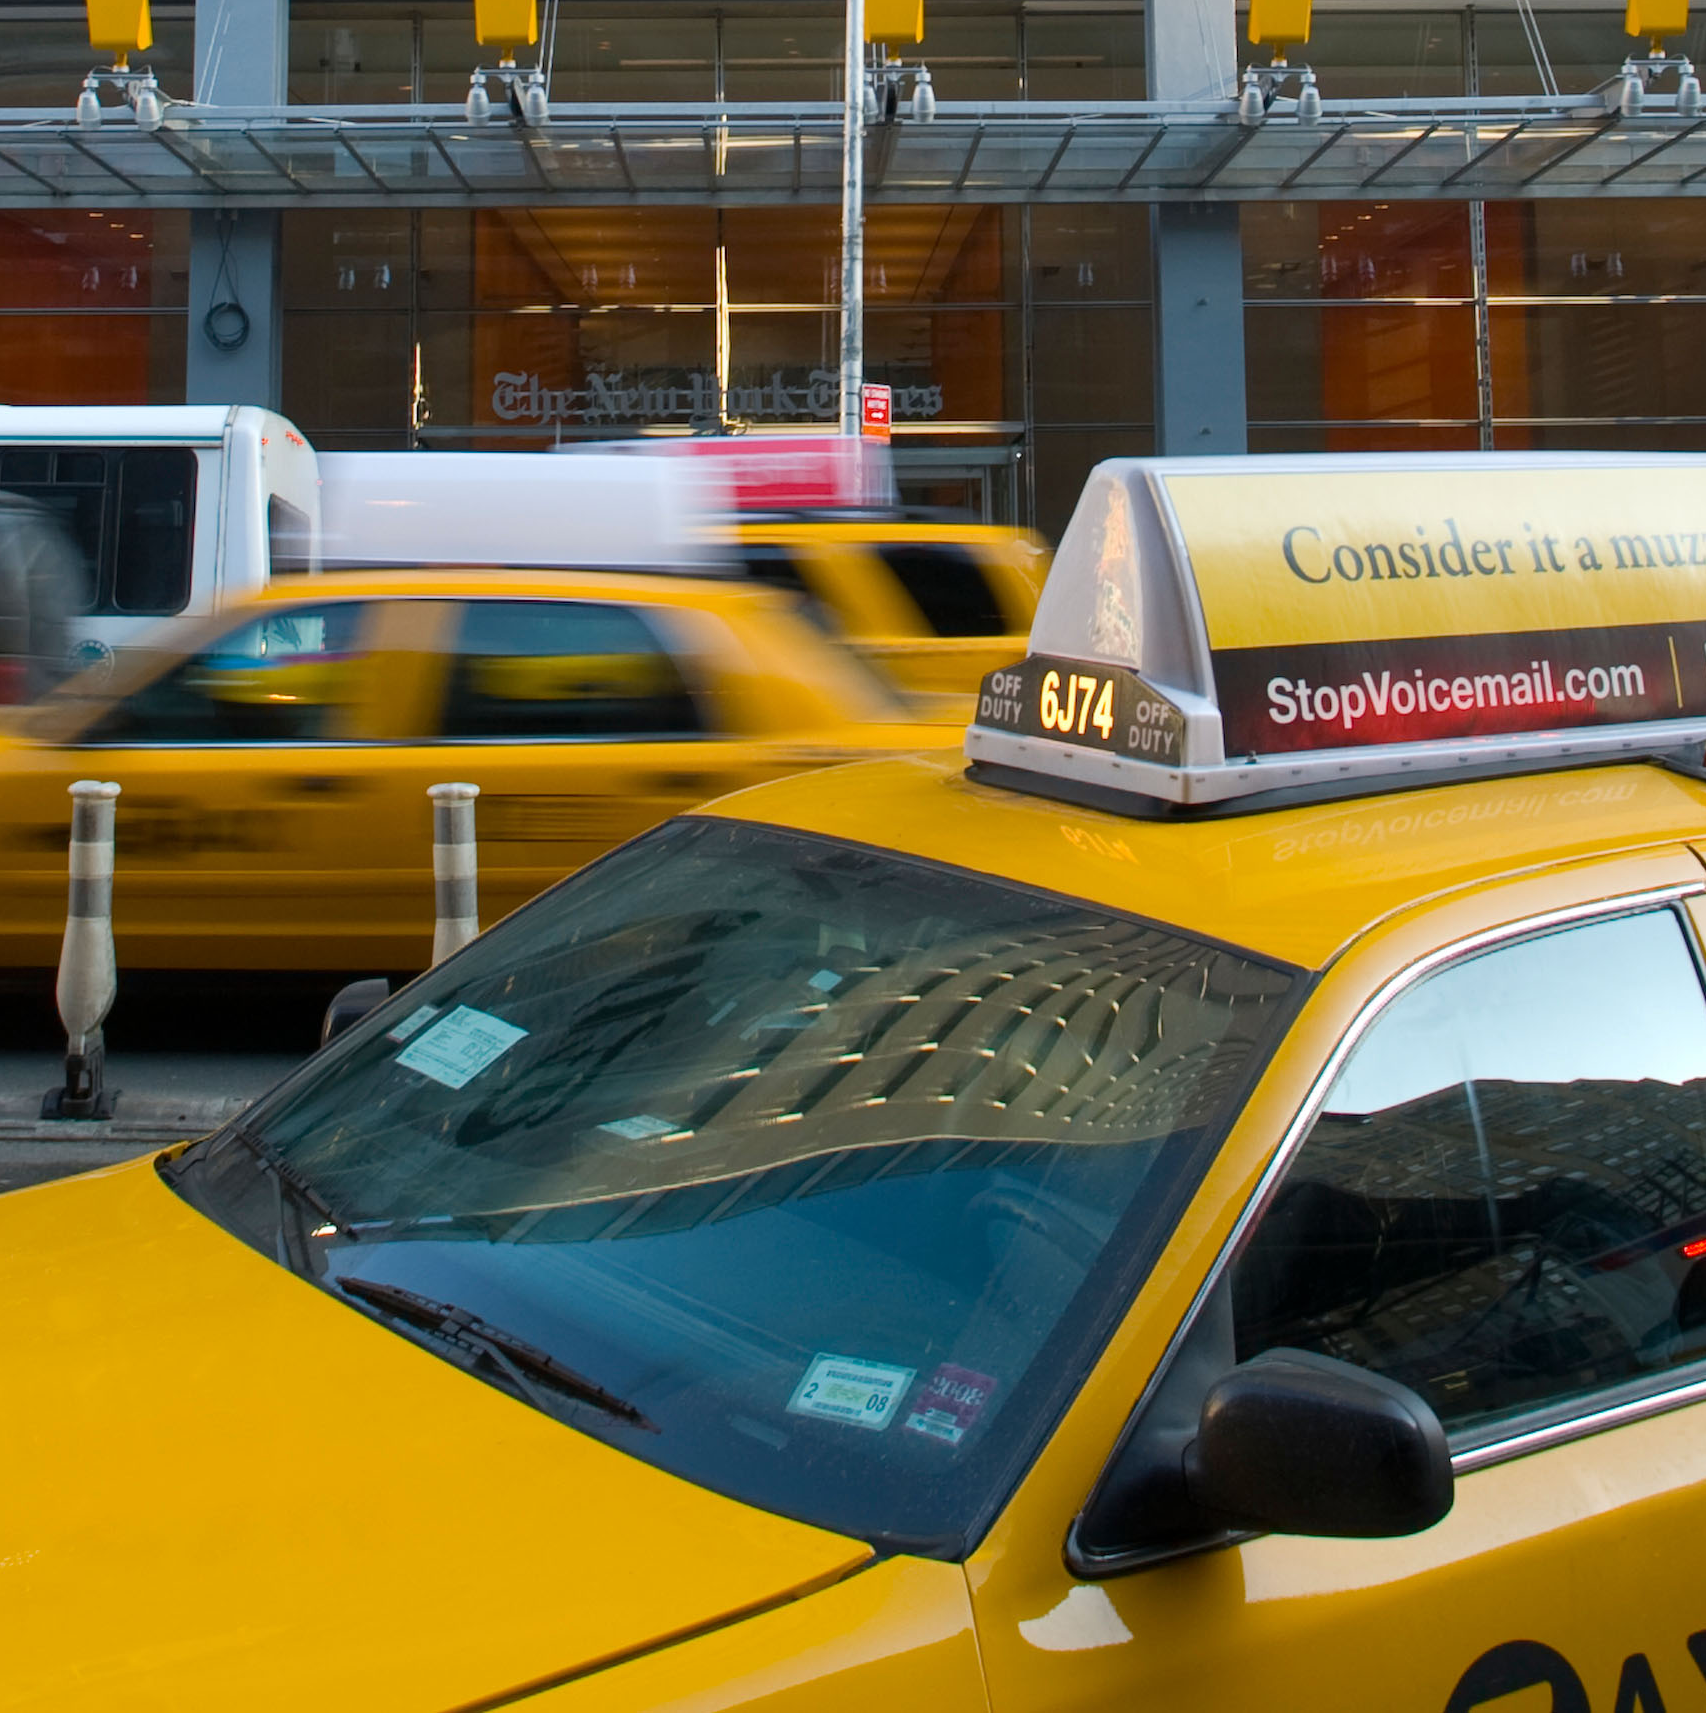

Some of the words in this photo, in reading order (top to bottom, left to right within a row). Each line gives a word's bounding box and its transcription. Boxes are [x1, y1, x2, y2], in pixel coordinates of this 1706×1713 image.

[493, 371, 579, 423] The
[583, 371, 681, 424] New
[689, 371, 798, 432] York
[806, 370, 943, 417] Tes
[1283, 518, 1515, 583] Consider
[1523, 522, 1565, 573] it
[1574, 536, 1602, 571] a
[990, 672, 1023, 698] OFF
[1267, 660, 1646, 729] StopVoicemail.com
[980, 696, 1023, 724] DUTY
[1040, 670, 1114, 740] 6J74
[1136, 700, 1171, 726] OFF
[1128, 726, 1174, 755] DUTY
[803, 1382, 819, 1399] 2
[866, 1394, 889, 1413] 08
